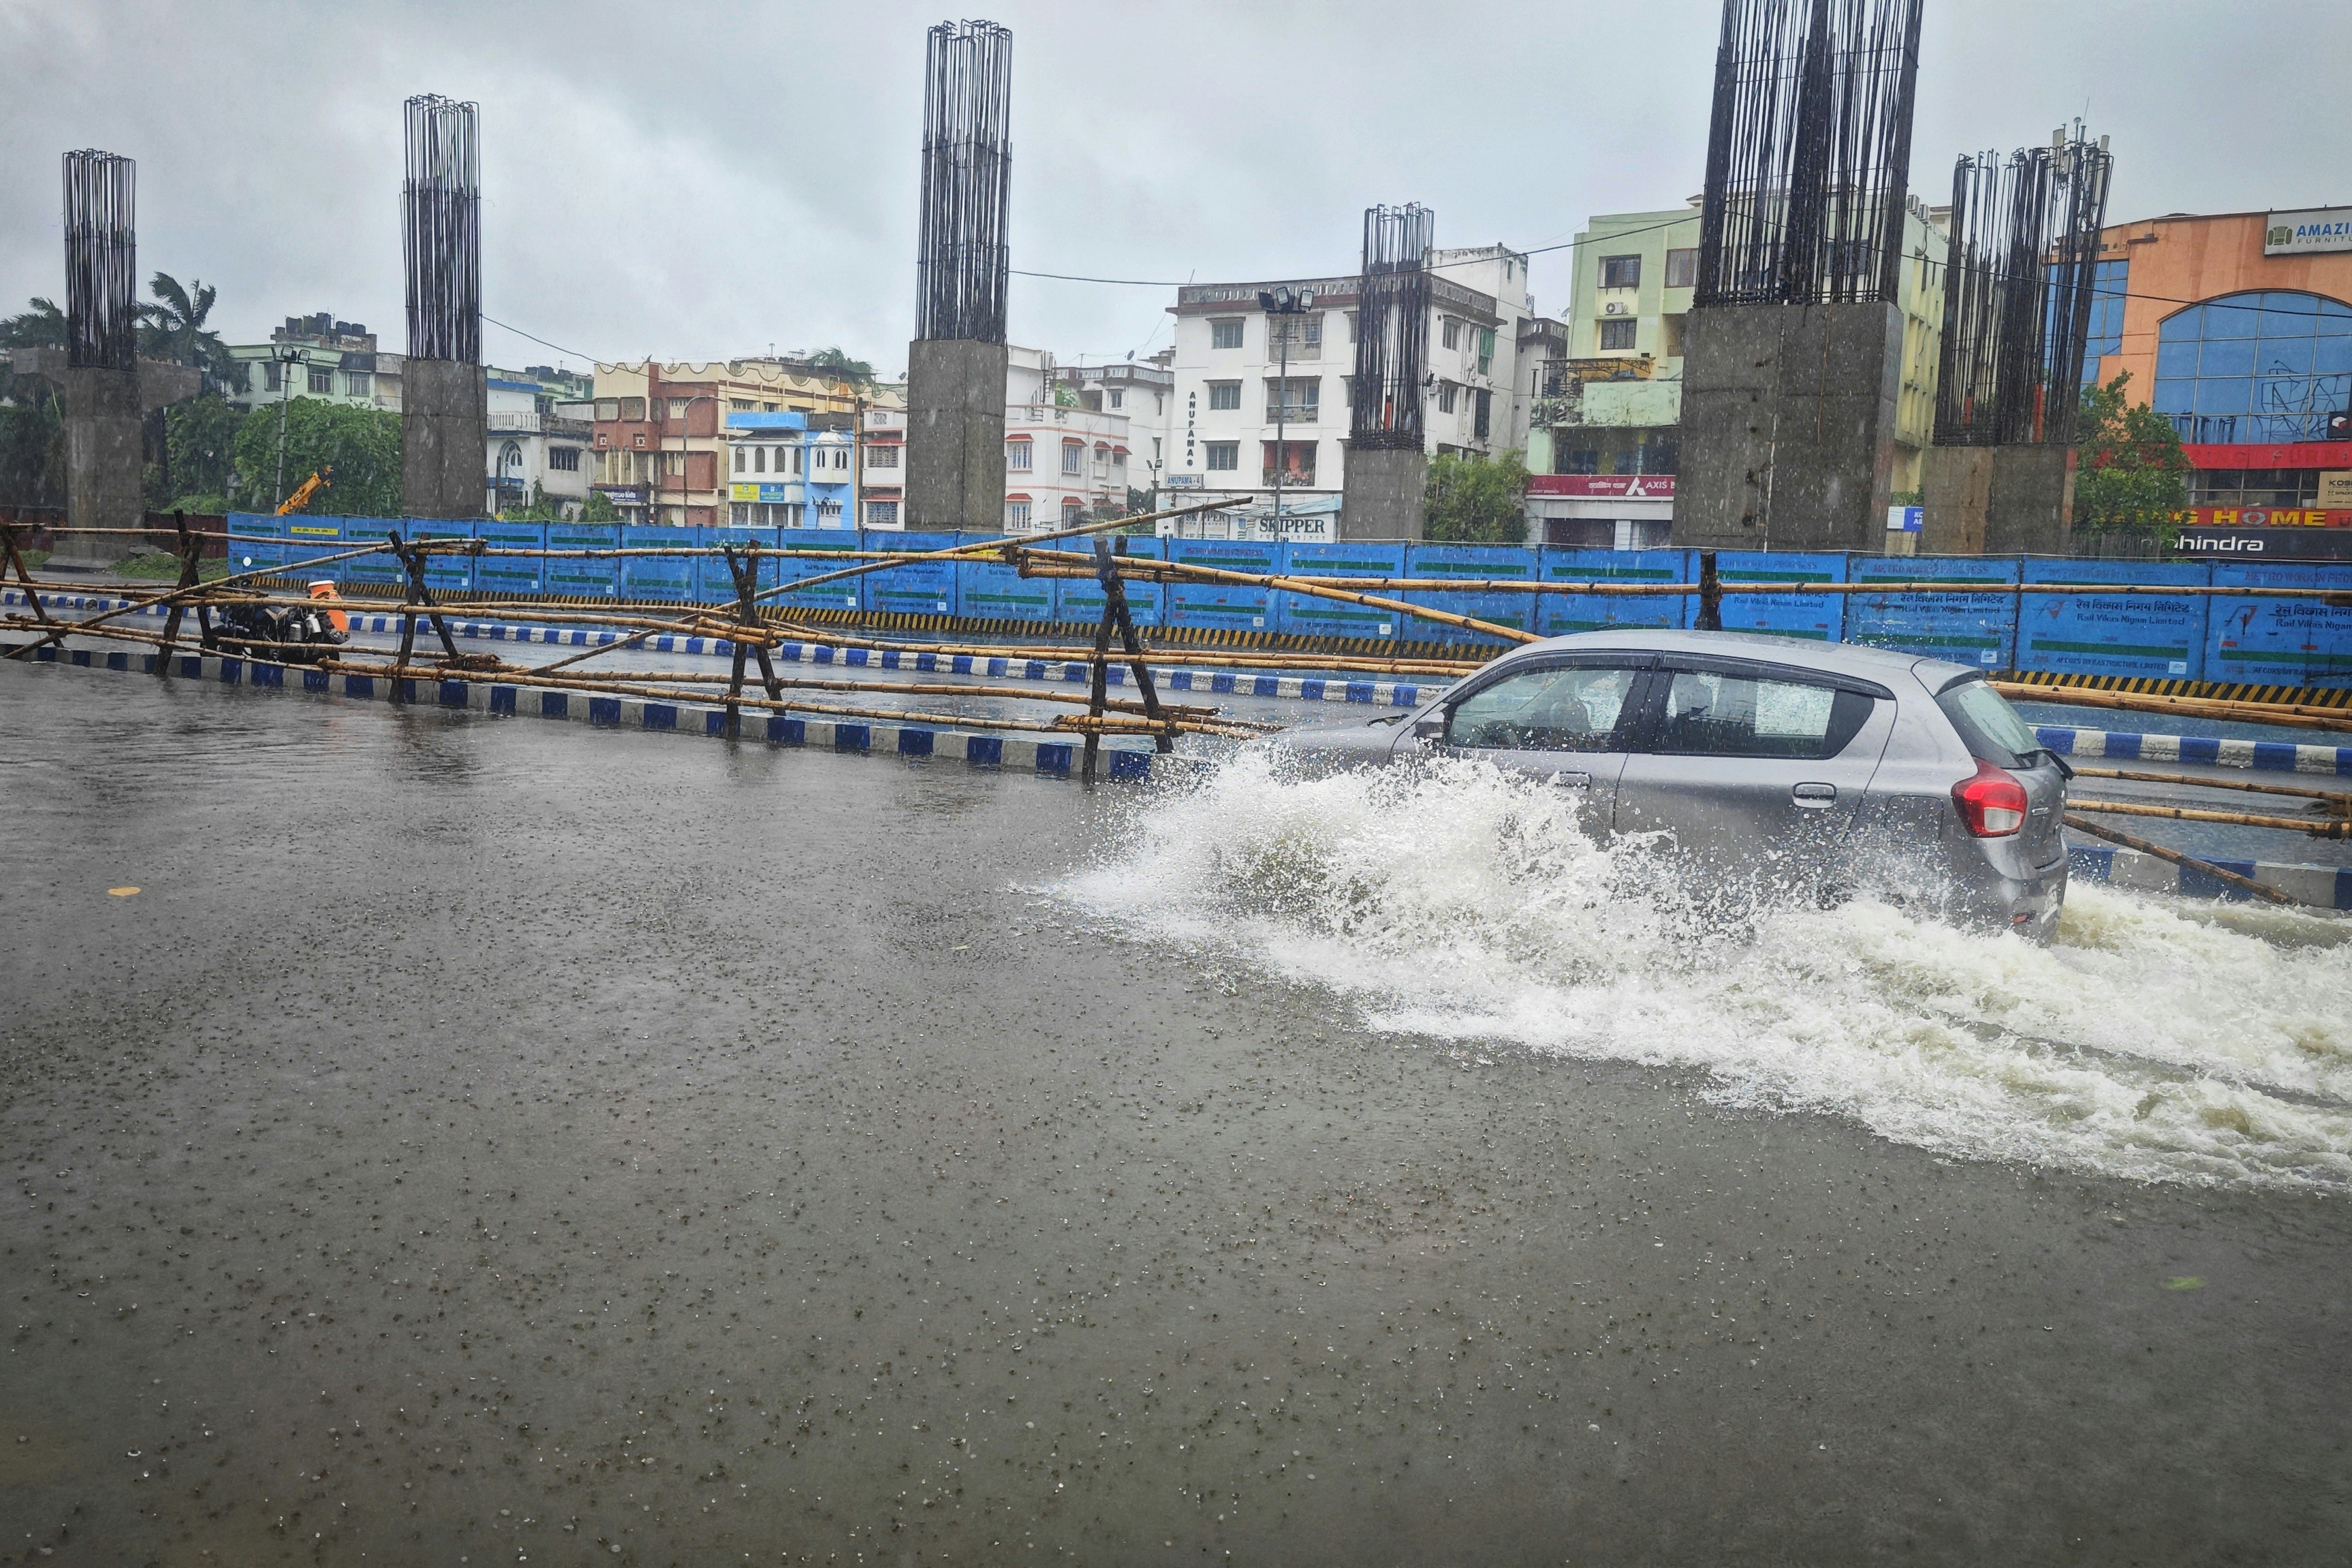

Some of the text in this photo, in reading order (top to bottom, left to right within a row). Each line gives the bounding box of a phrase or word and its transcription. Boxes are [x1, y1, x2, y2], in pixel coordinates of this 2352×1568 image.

[2296, 223, 2352, 237] AMAZI
[2213, 510, 2326, 526] HOME
[1260, 518, 1325, 533] SKIPPER
[2141, 535, 2264, 551] hindra
[2245, 571, 2282, 581] METRO
[2285, 572, 2313, 582] WORK
[2328, 574, 2352, 583] PRO
[2331, 606, 2352, 617] निग
[2097, 614, 2119, 623] Vikas
[2121, 615, 2147, 625] Nigam
[2276, 619, 2295, 627] Rail
[2297, 619, 2323, 629] Vikas
